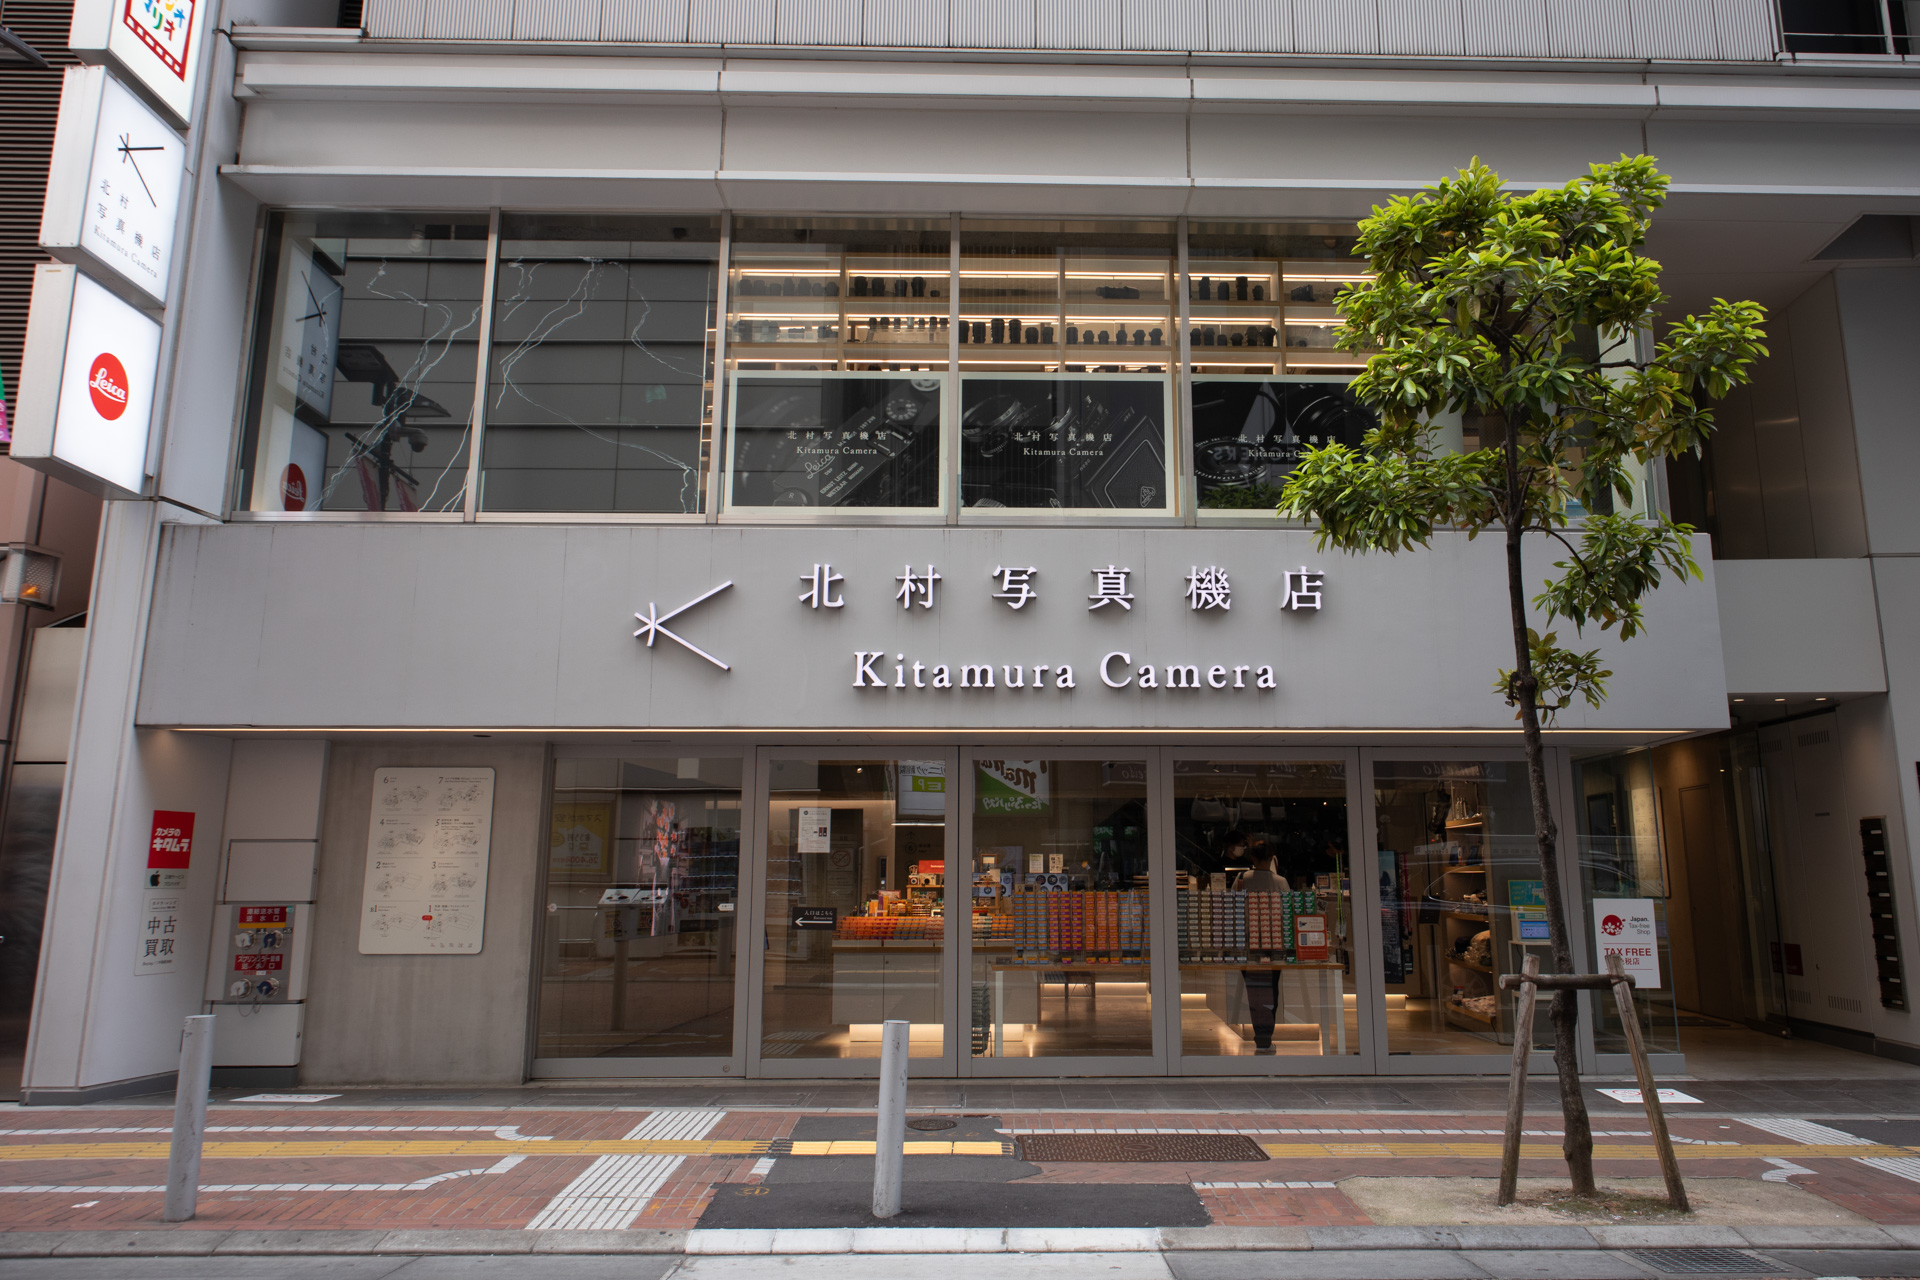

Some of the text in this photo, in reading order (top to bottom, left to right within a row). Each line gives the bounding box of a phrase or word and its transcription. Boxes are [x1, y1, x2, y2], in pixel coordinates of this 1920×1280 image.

[100, 179, 130, 209] 北村
[97, 202, 161, 261] 写真機店
[94, 225, 158, 278] Kitamura Camera
[90, 368, 126, 403] Leica
[788, 430, 887, 441] 北村写真機店
[1013, 432, 1113, 442] 北村写真機店
[797, 446, 878, 455] Kitamura Camera
[1023, 447, 1104, 456] Kitamura Camera
[1248, 449, 1291, 458] Kitamura
[805, 453, 836, 480] Leica
[799, 564, 1326, 611] 北村写真機店
[853, 651, 1278, 690] Kitamura Camera
[383, 776, 389, 784] 6
[438, 776, 444, 785] 7
[379, 818, 385, 826] 4
[435, 818, 441, 827] 5
[155, 827, 181, 837] カメラの
[152, 838, 190, 853] キタムラ
[376, 861, 381, 869] 2
[431, 861, 437, 869] 3
[148, 916, 177, 935] 中古
[144, 938, 175, 957] 買取
[1604, 948, 1652, 956] TAX FREE
